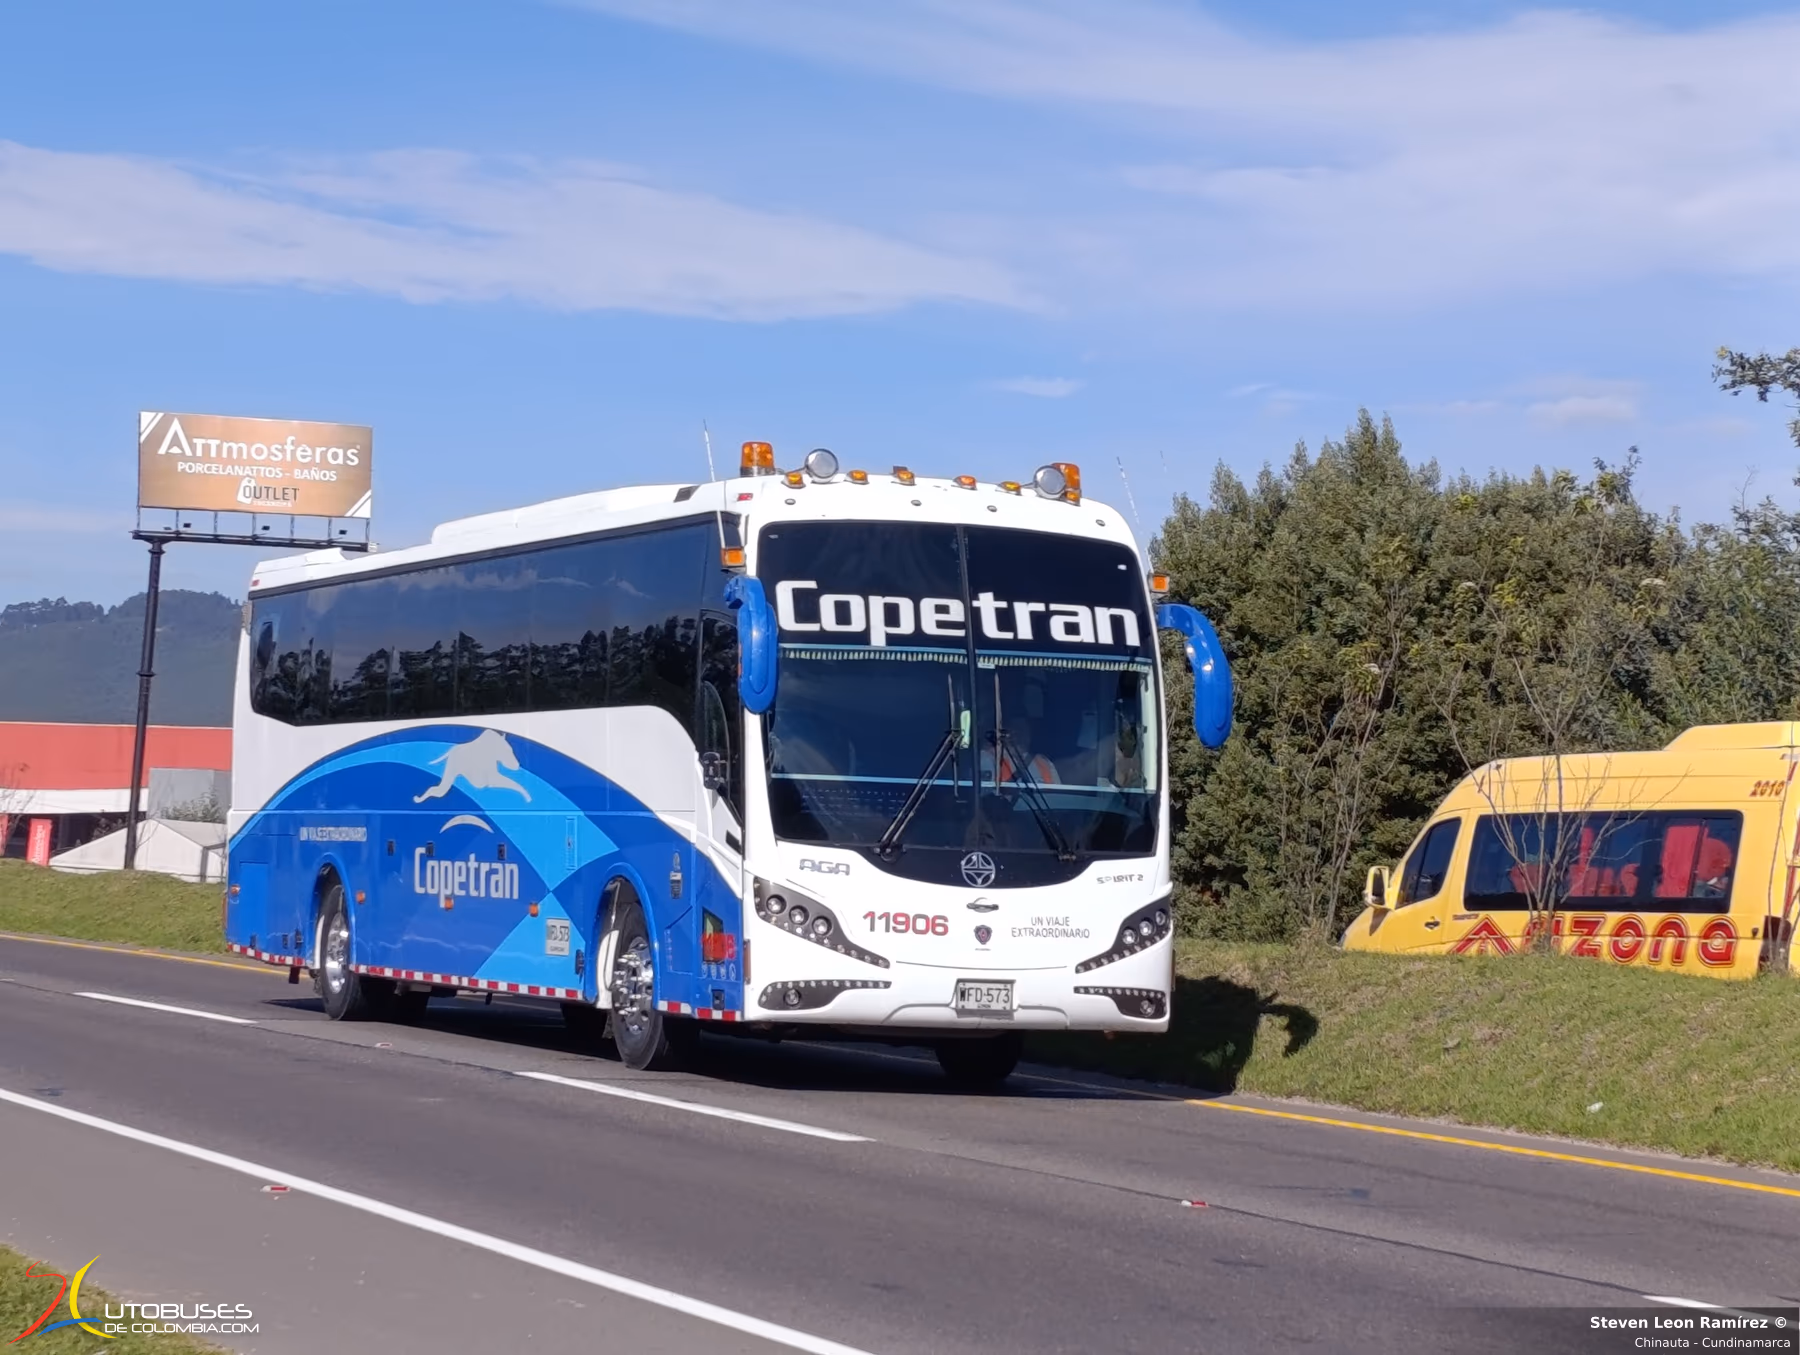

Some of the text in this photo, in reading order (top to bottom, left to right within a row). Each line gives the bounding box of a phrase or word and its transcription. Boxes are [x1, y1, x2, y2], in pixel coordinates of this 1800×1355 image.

[177, 461, 283, 479] PORCELANATTOS
[294, 467, 337, 481] BAÑOS
[243, 485, 298, 501] OUTLET
[775, 580, 1140, 647] Copetran
[799, 858, 850, 876] AGA
[413, 847, 519, 908] Copetran
[863, 911, 949, 936] 11906
[1031, 916, 1070, 926] UN VIAJE
[1011, 927, 1090, 938] EXTRAORDINARIO
